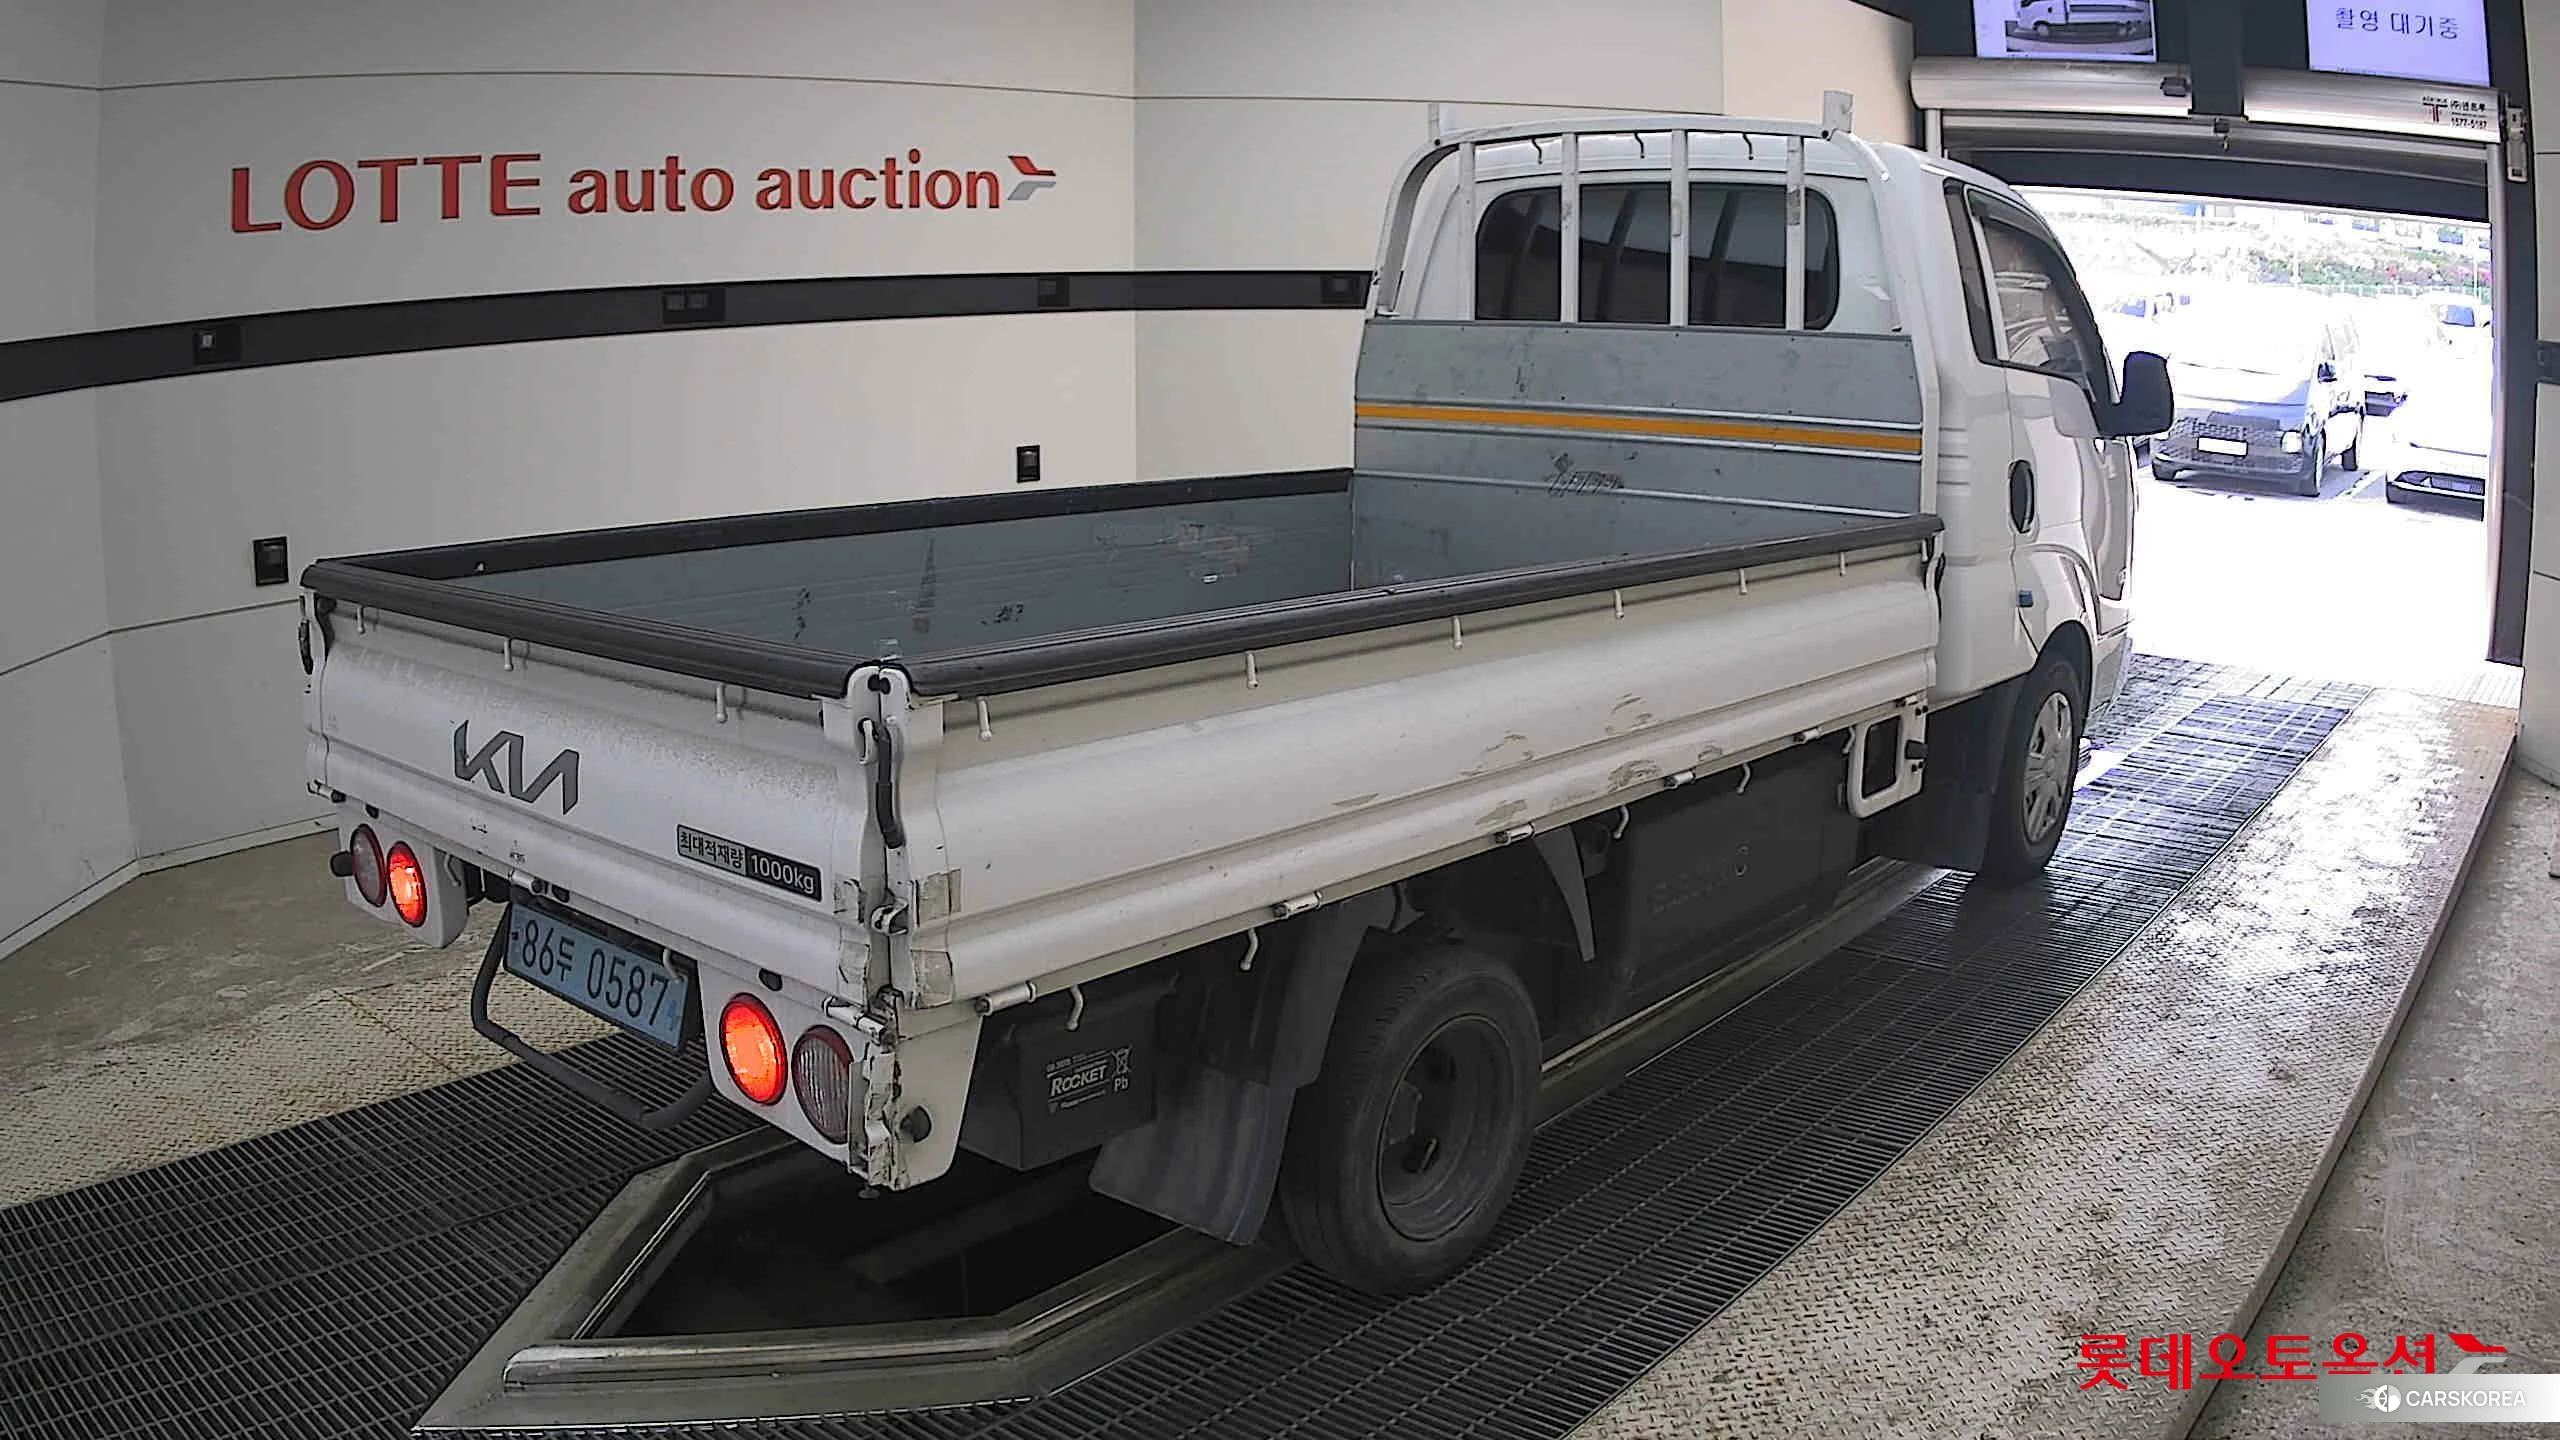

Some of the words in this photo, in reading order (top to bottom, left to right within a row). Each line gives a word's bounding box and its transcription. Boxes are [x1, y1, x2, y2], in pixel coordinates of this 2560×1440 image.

[2336, 7, 2378, 32] 촬영
[2390, 13, 2460, 39] 대기중
[231, 153, 541, 233] LOTTE
[568, 156, 734, 214] auto
[756, 148, 1000, 210] auction
[453, 719, 580, 816] KIA
[680, 832, 744, 869] 최대적재량
[751, 855, 814, 894] 1000kg
[522, 919, 575, 982] 86두
[587, 949, 670, 1026] 0587
[1050, 1065, 1107, 1096] ROCKET
[1114, 1076, 1129, 1092] Pb
